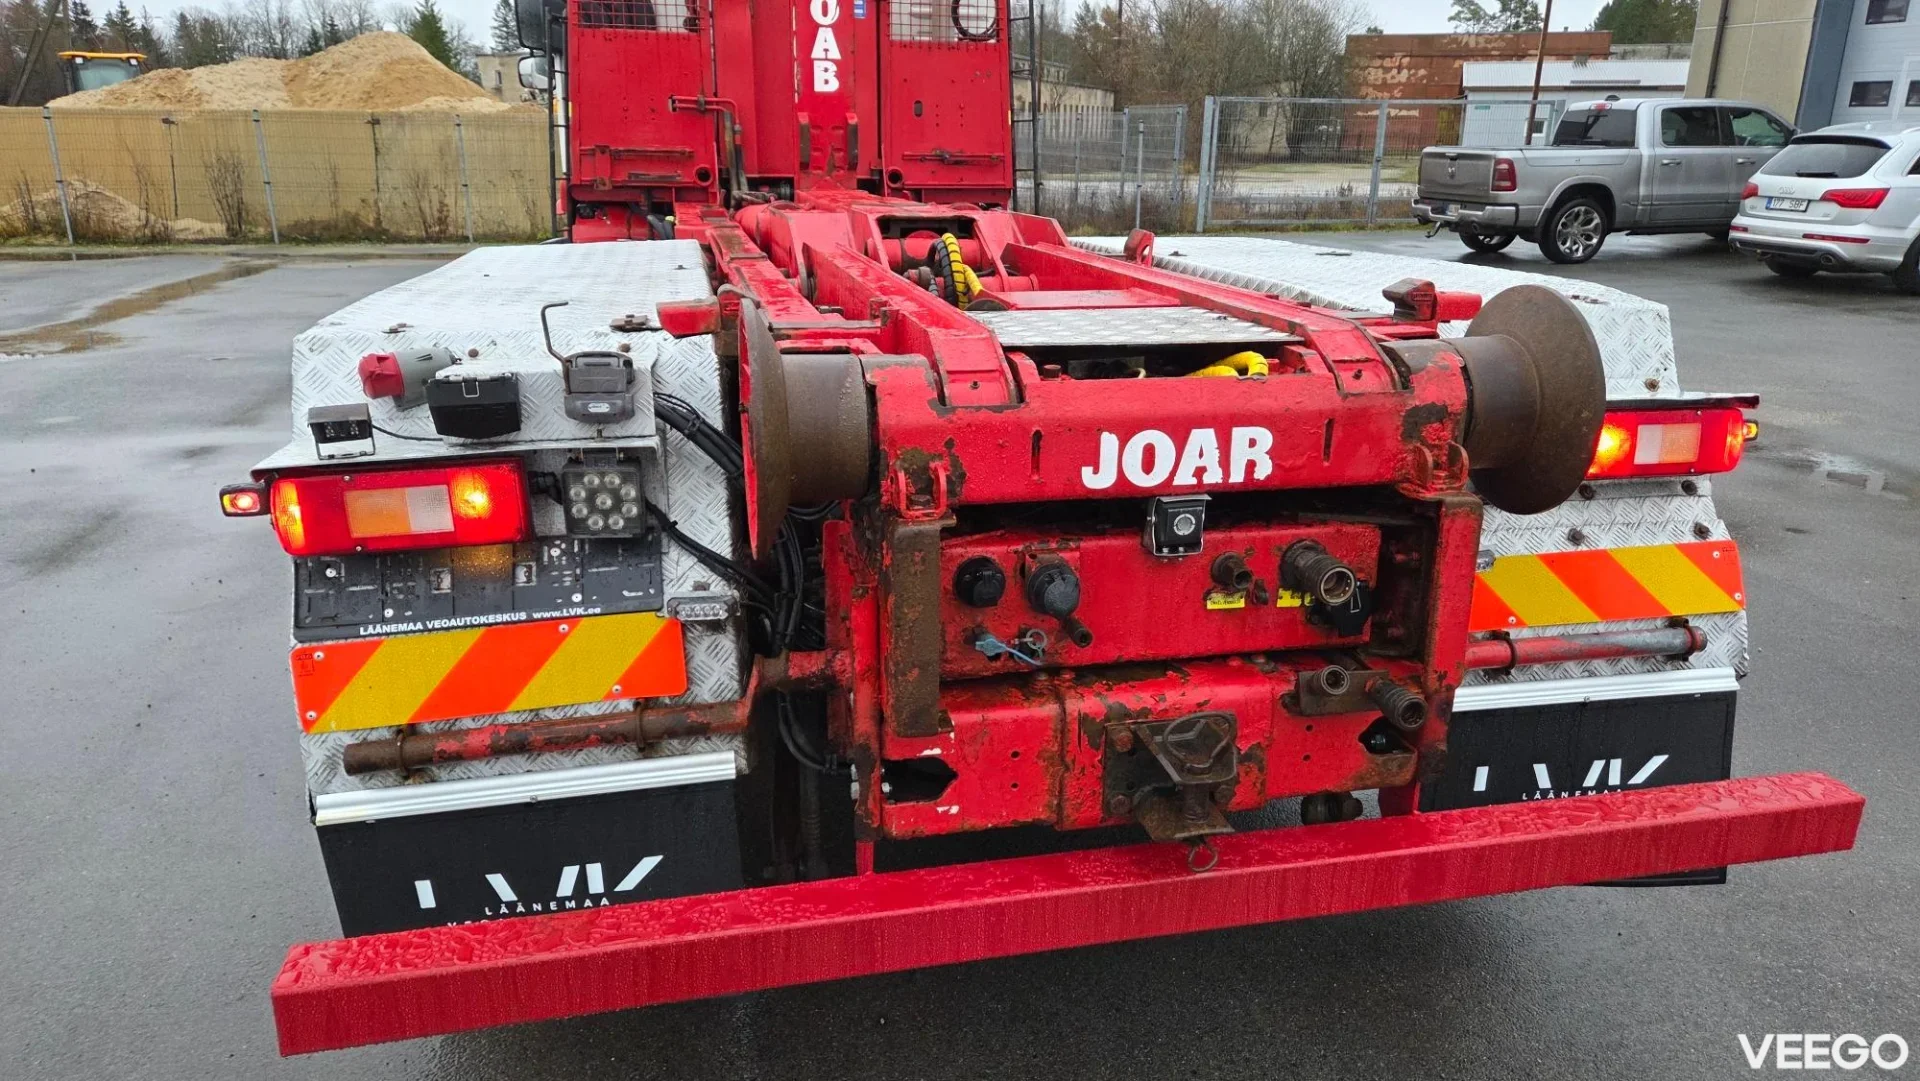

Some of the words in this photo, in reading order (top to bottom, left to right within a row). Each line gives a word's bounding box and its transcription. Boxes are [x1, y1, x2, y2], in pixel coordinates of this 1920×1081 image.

[359, 621, 424, 636] LÄÄNEMAA
[426, 611, 527, 630] VEOAUTOKESKUS
[532, 606, 602, 619] www.LVK.ee
[484, 896, 610, 916] LÄÄNEMAA
